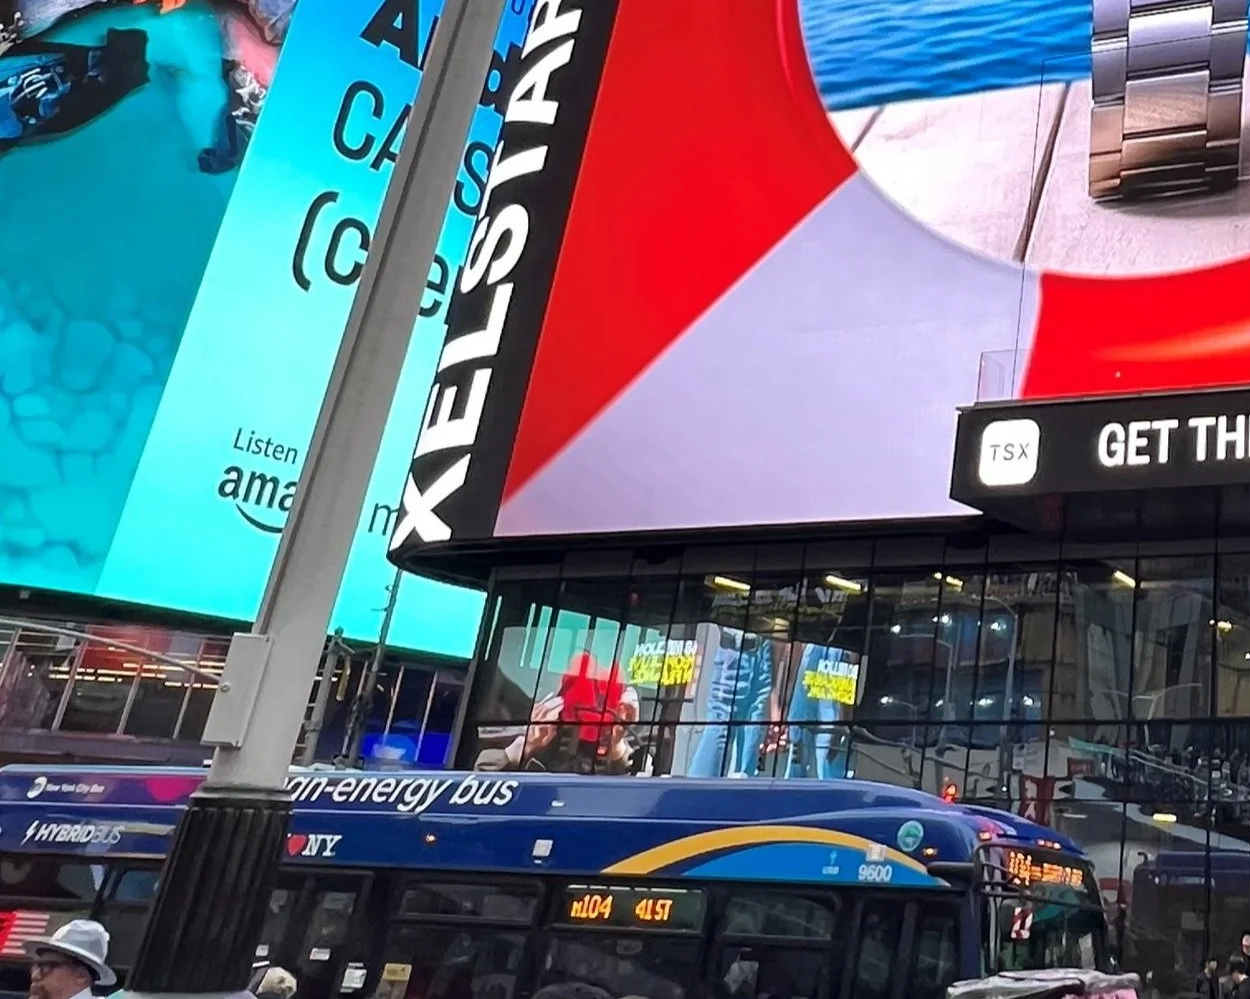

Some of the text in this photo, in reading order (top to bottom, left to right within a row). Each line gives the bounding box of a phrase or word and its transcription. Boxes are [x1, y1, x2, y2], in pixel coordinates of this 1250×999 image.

[233, 428, 298, 465] Listen
[989, 443, 1029, 462] TSX
[1099, 419, 1178, 468] GET
[284, 775, 519, 813] an-energy bus
[35, 823, 125, 844] HYBRIDBUS
[858, 864, 893, 882] 9600
[635, 899, 673, 921] 41ST
